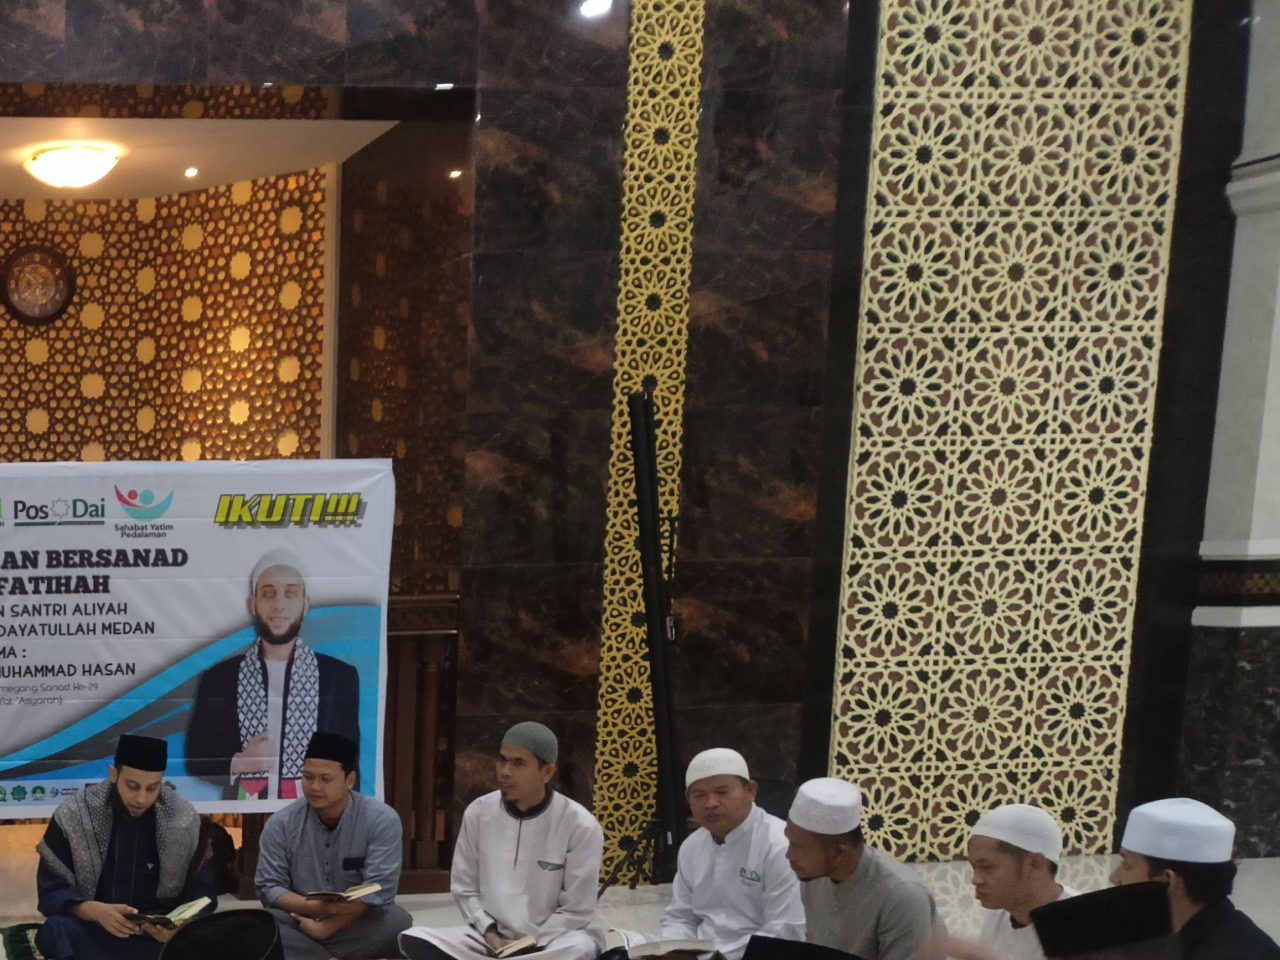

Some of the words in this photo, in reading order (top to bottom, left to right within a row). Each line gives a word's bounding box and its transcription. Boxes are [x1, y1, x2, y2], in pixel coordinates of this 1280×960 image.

[13, 500, 49, 520] Pos
[72, 498, 105, 518] Dai
[214, 492, 364, 527] IKUTI!!!
[114, 523, 148, 531] Sahabat
[150, 522, 173, 531] Yatim
[0, 551, 39, 569] AN
[46, 548, 189, 569] BERSANAD
[10, 603, 67, 617] SANTRI
[72, 602, 128, 616] ALIYAH
[101, 621, 155, 635] MEDAN
[82, 662, 136, 676] HASAN
[40, 682, 70, 692] Sanad
